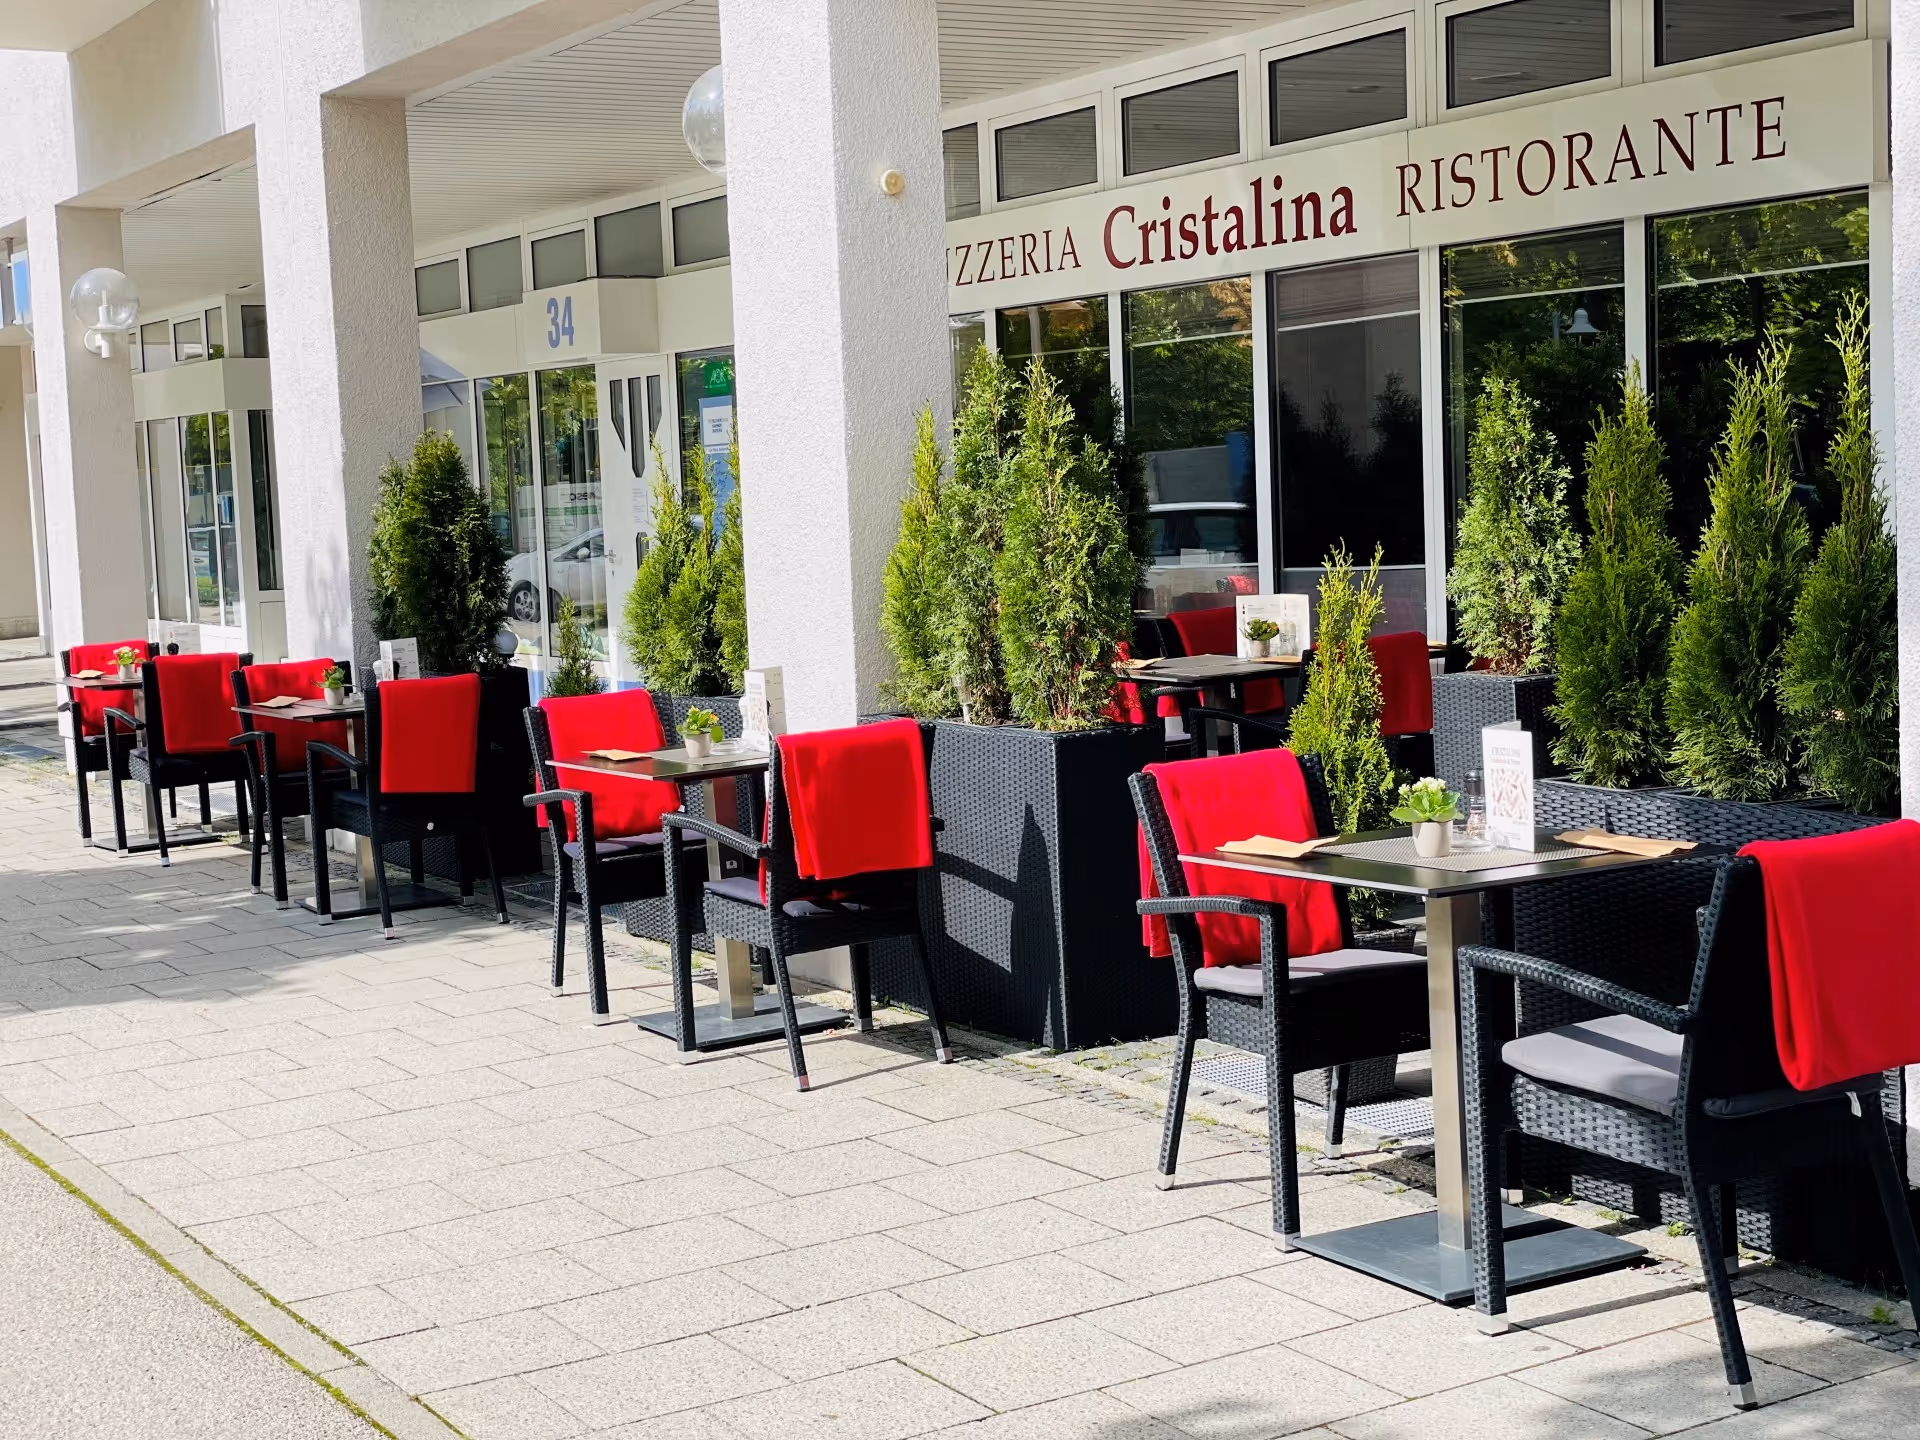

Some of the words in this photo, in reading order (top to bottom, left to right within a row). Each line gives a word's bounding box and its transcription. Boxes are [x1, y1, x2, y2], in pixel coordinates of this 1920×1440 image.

[1103, 174, 1358, 270] Cristalina
[1395, 96, 1787, 218] RISTORANTE
[546, 296, 575, 349] 34
